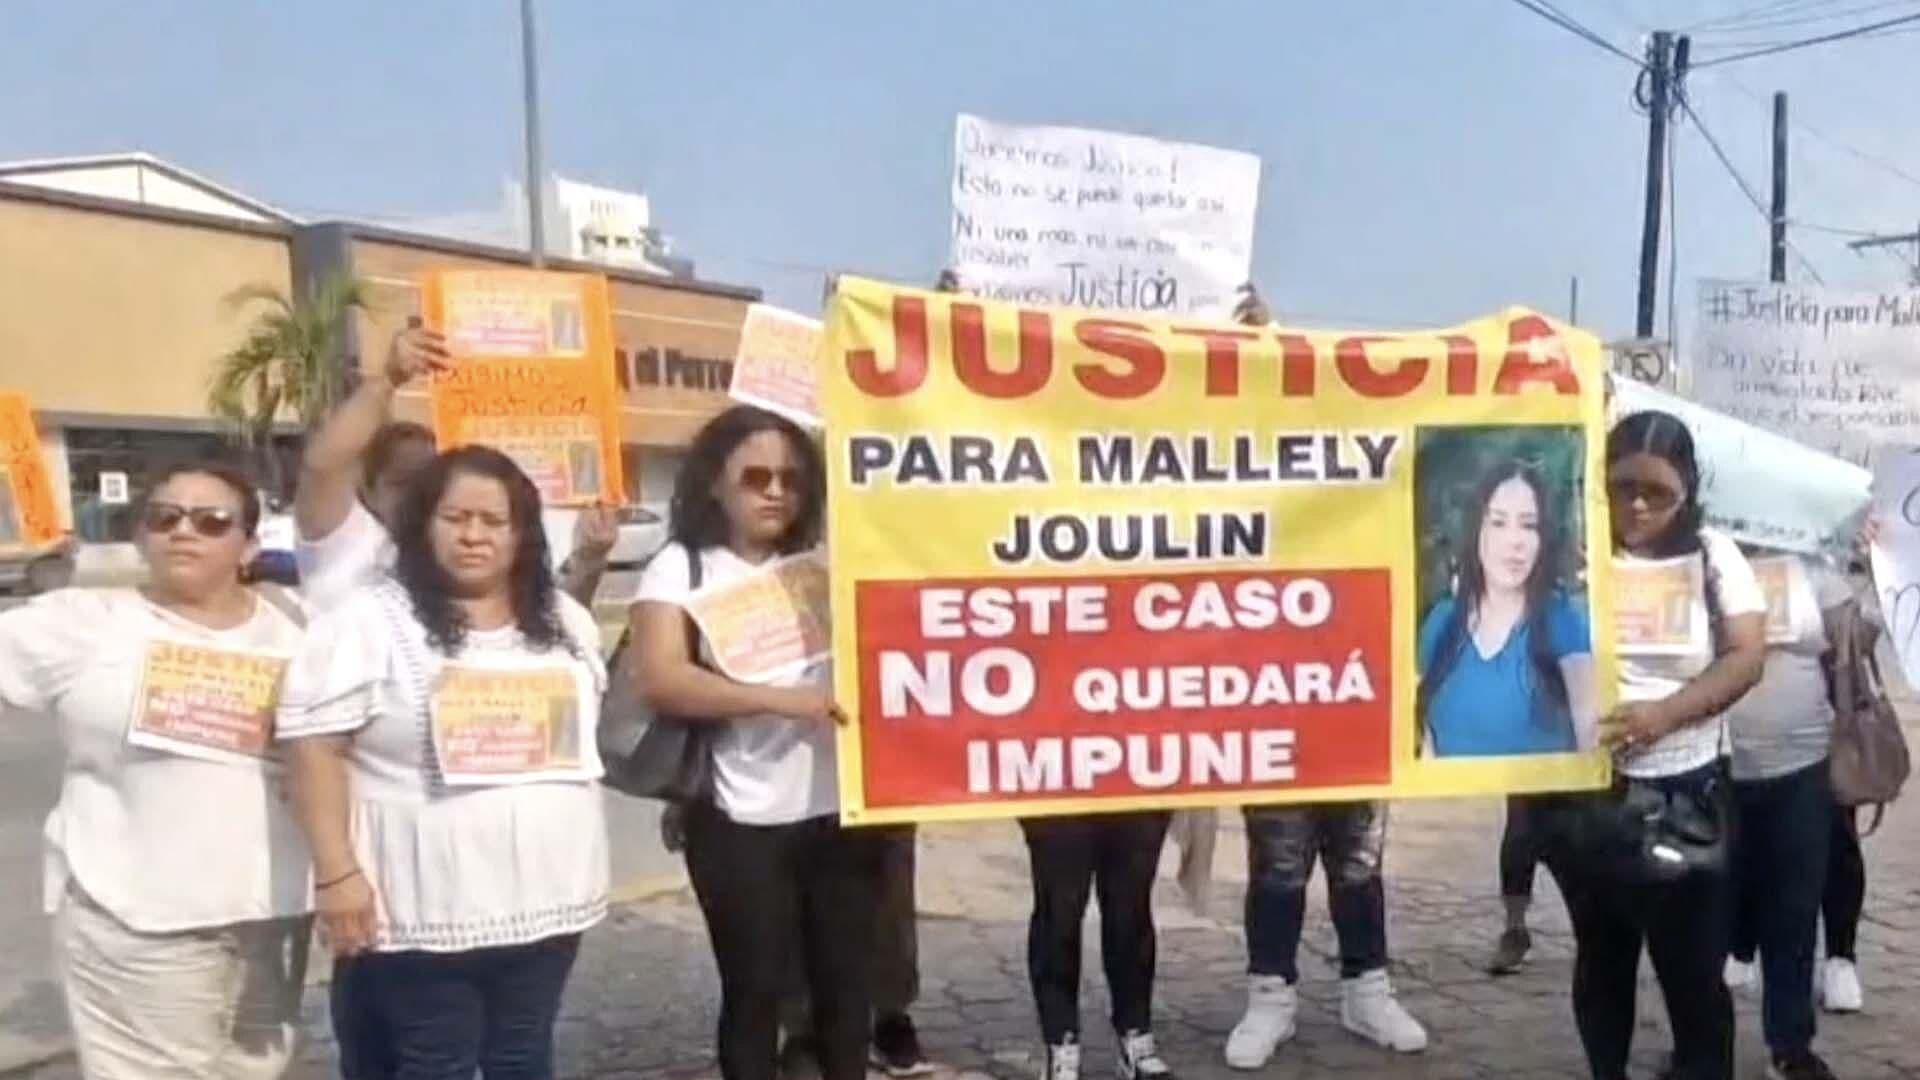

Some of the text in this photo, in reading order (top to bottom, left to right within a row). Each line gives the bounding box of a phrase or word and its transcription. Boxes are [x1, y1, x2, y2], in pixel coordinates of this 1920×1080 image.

[844, 294, 1581, 399] JUSTICIA
[849, 433, 1400, 485] PARA MALLELY
[993, 512, 1267, 562] JOULIN
[919, 578, 1333, 640] ESTE CASO
[878, 648, 1376, 719] NO QUEDARÁ
[966, 729, 1297, 794] IMPUNE
